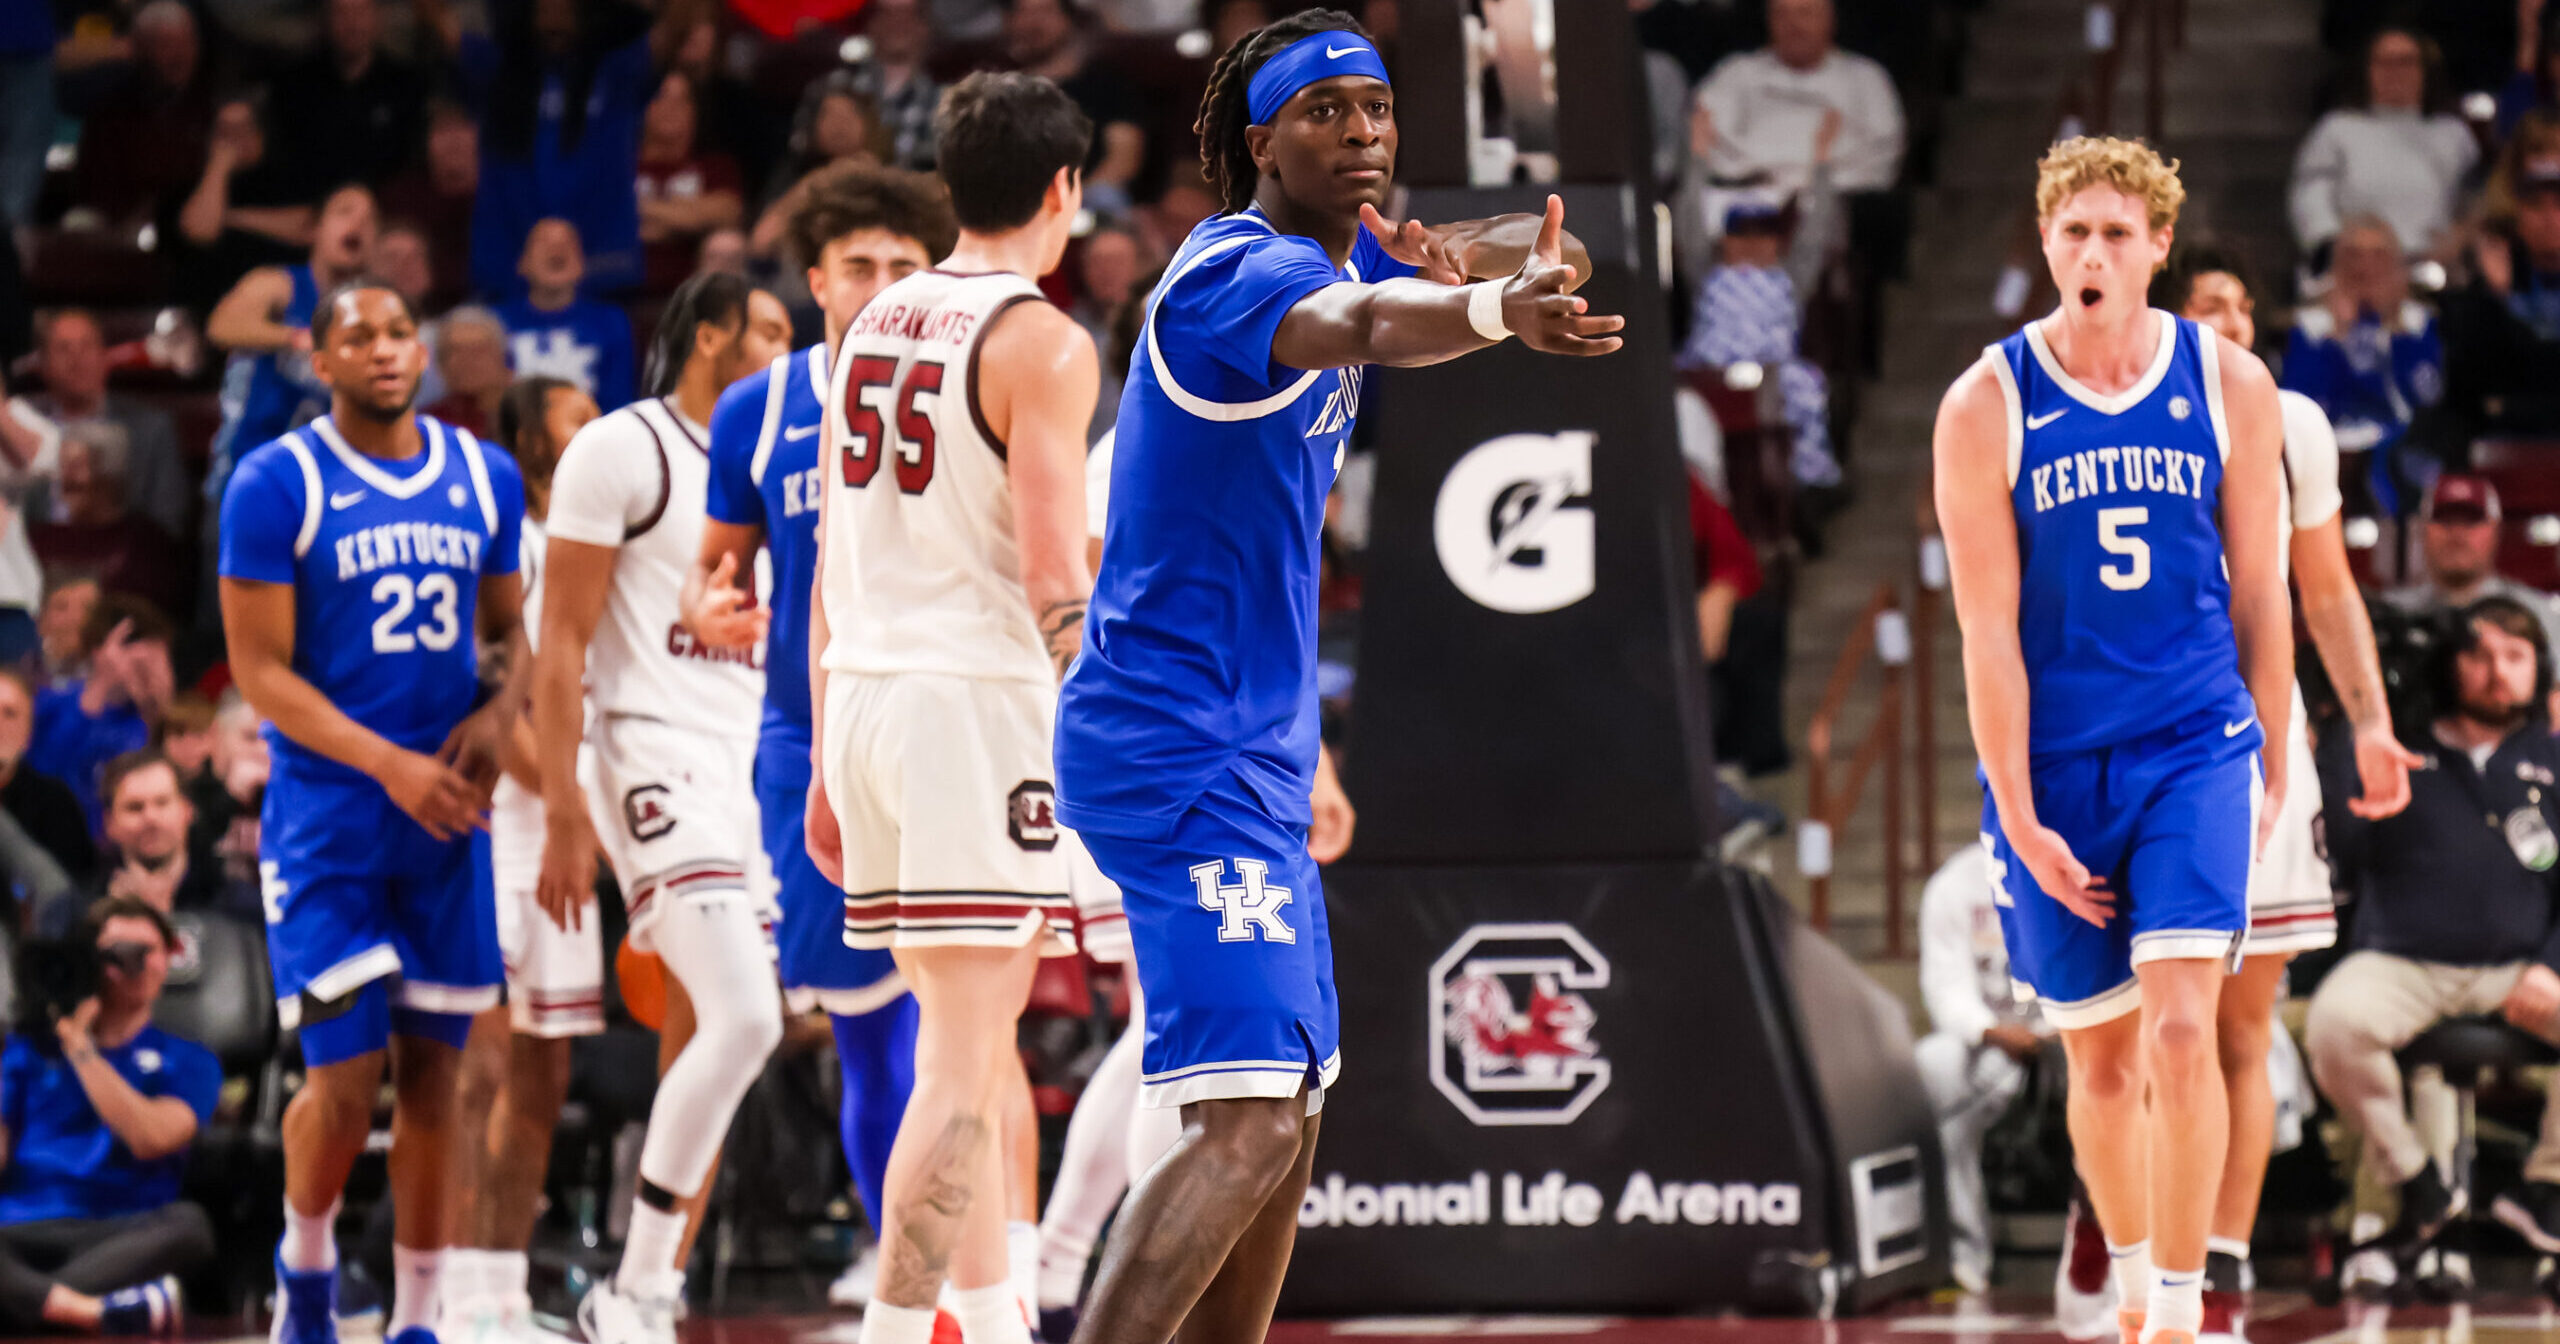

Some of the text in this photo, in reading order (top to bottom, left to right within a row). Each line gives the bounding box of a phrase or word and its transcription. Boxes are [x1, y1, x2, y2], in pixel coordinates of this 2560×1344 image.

[842, 354, 945, 496] 55
[2032, 446, 2206, 513] KENTUCKY
[335, 521, 482, 582] KENTUCKY
[1434, 429, 1599, 614] G
[2098, 507, 2151, 590] 5
[371, 573, 460, 653] 23
[1189, 858, 1296, 945] UK
[1297, 1171, 1800, 1227] olonial Life Arena
